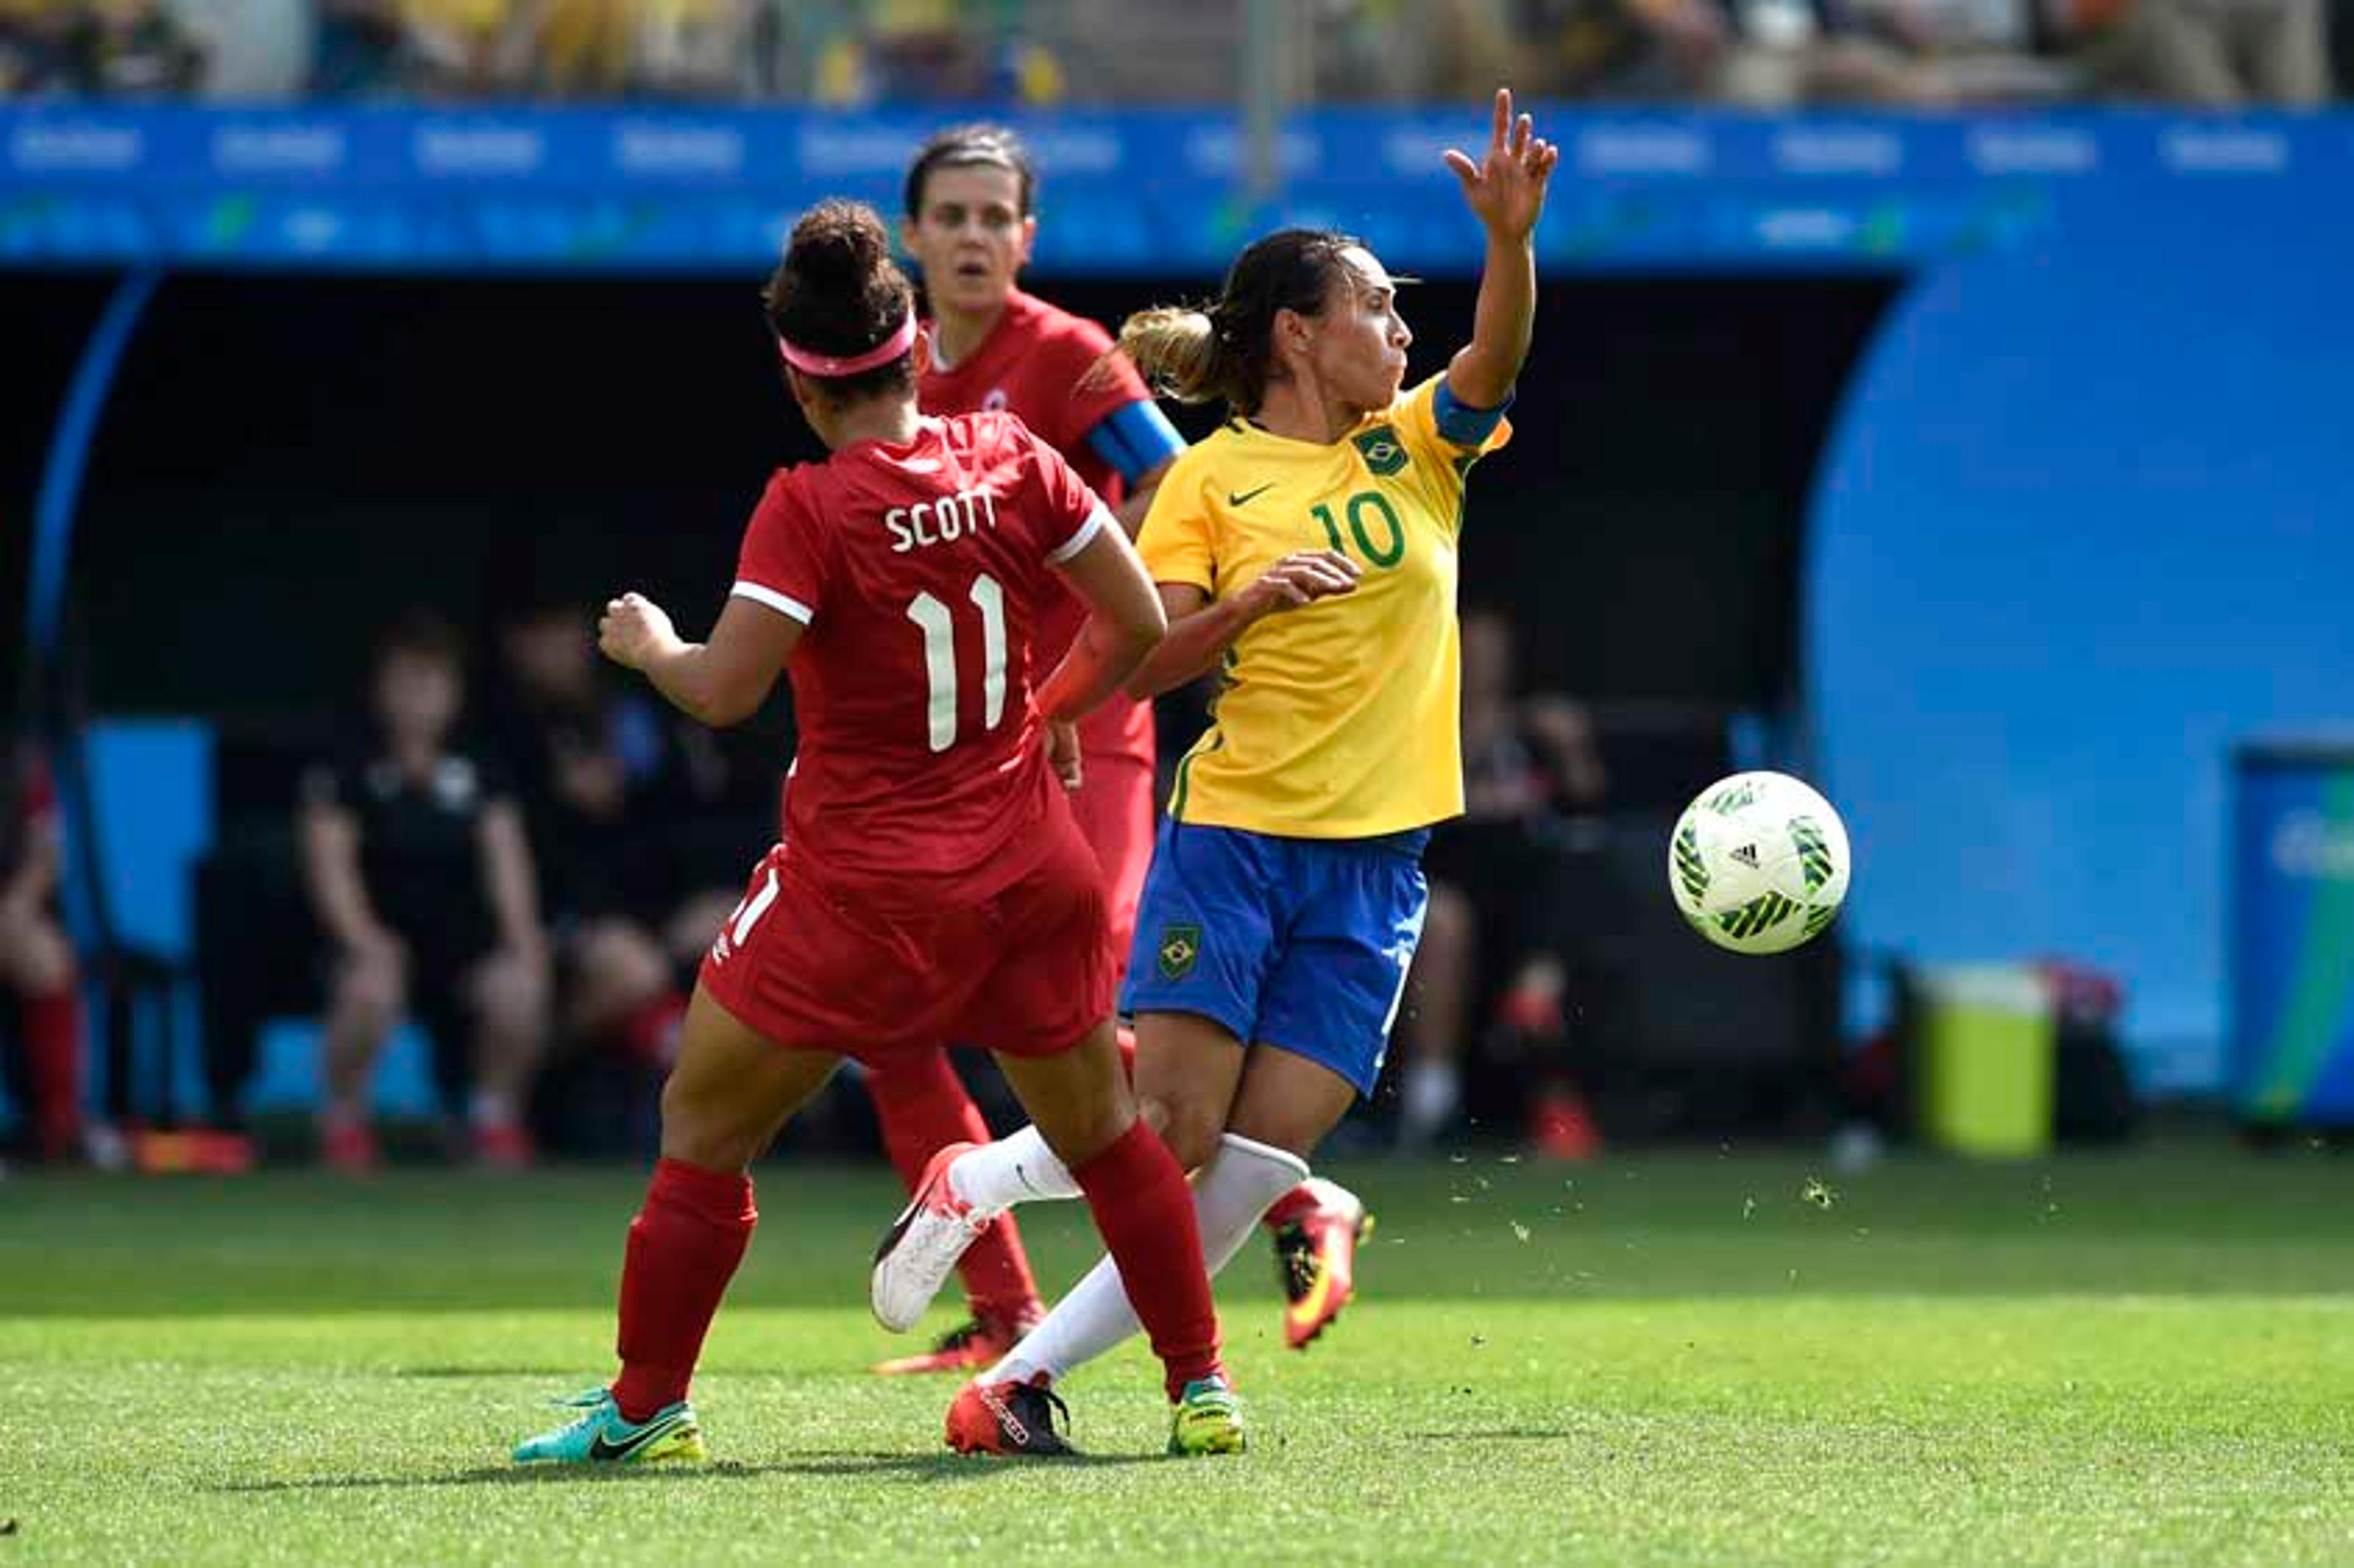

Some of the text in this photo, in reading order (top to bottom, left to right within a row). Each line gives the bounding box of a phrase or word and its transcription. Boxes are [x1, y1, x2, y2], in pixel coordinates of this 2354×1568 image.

[885, 487, 998, 552] SCOTT
[1310, 490, 1405, 569] 10
[907, 573, 1007, 753] 11
